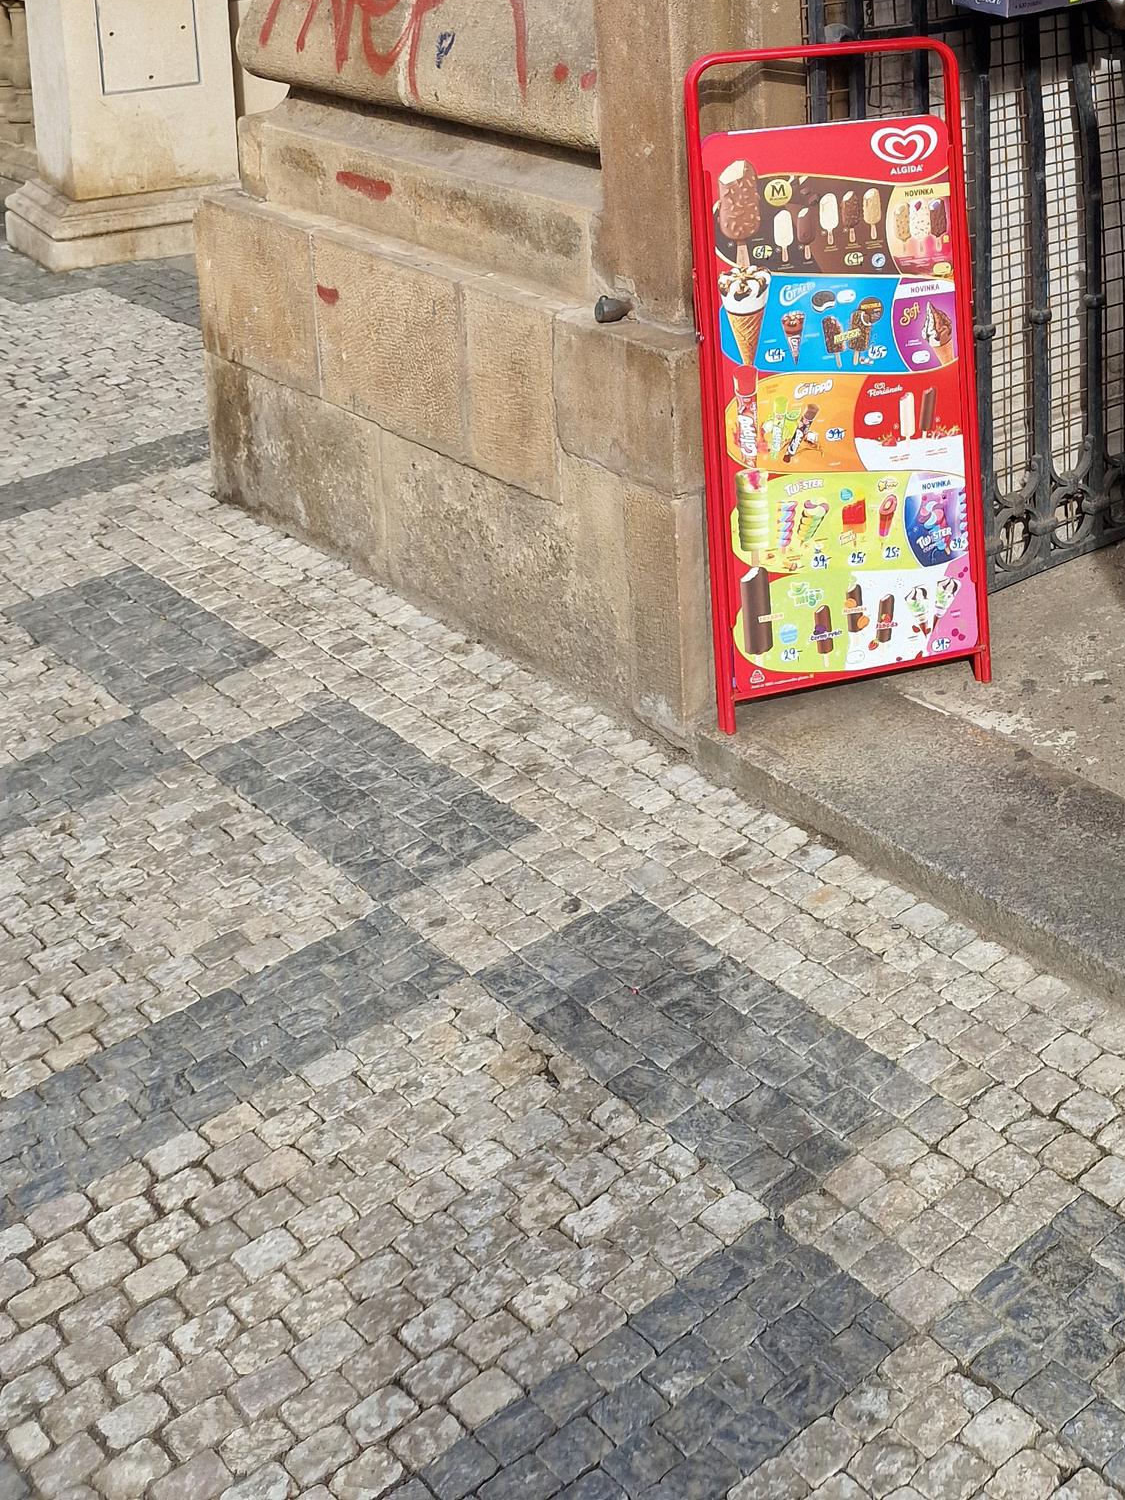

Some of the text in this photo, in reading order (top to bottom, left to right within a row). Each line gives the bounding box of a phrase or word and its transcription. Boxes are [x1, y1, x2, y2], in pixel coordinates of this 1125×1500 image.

[890, 165, 923, 175] ALGIDA
[904, 188, 934, 198] NOVINKA
[910, 284, 940, 294] NOVINKA
[900, 302, 920, 326] Soft
[794, 379, 833, 399] Calippo
[922, 480, 951, 491] NOVINKA
